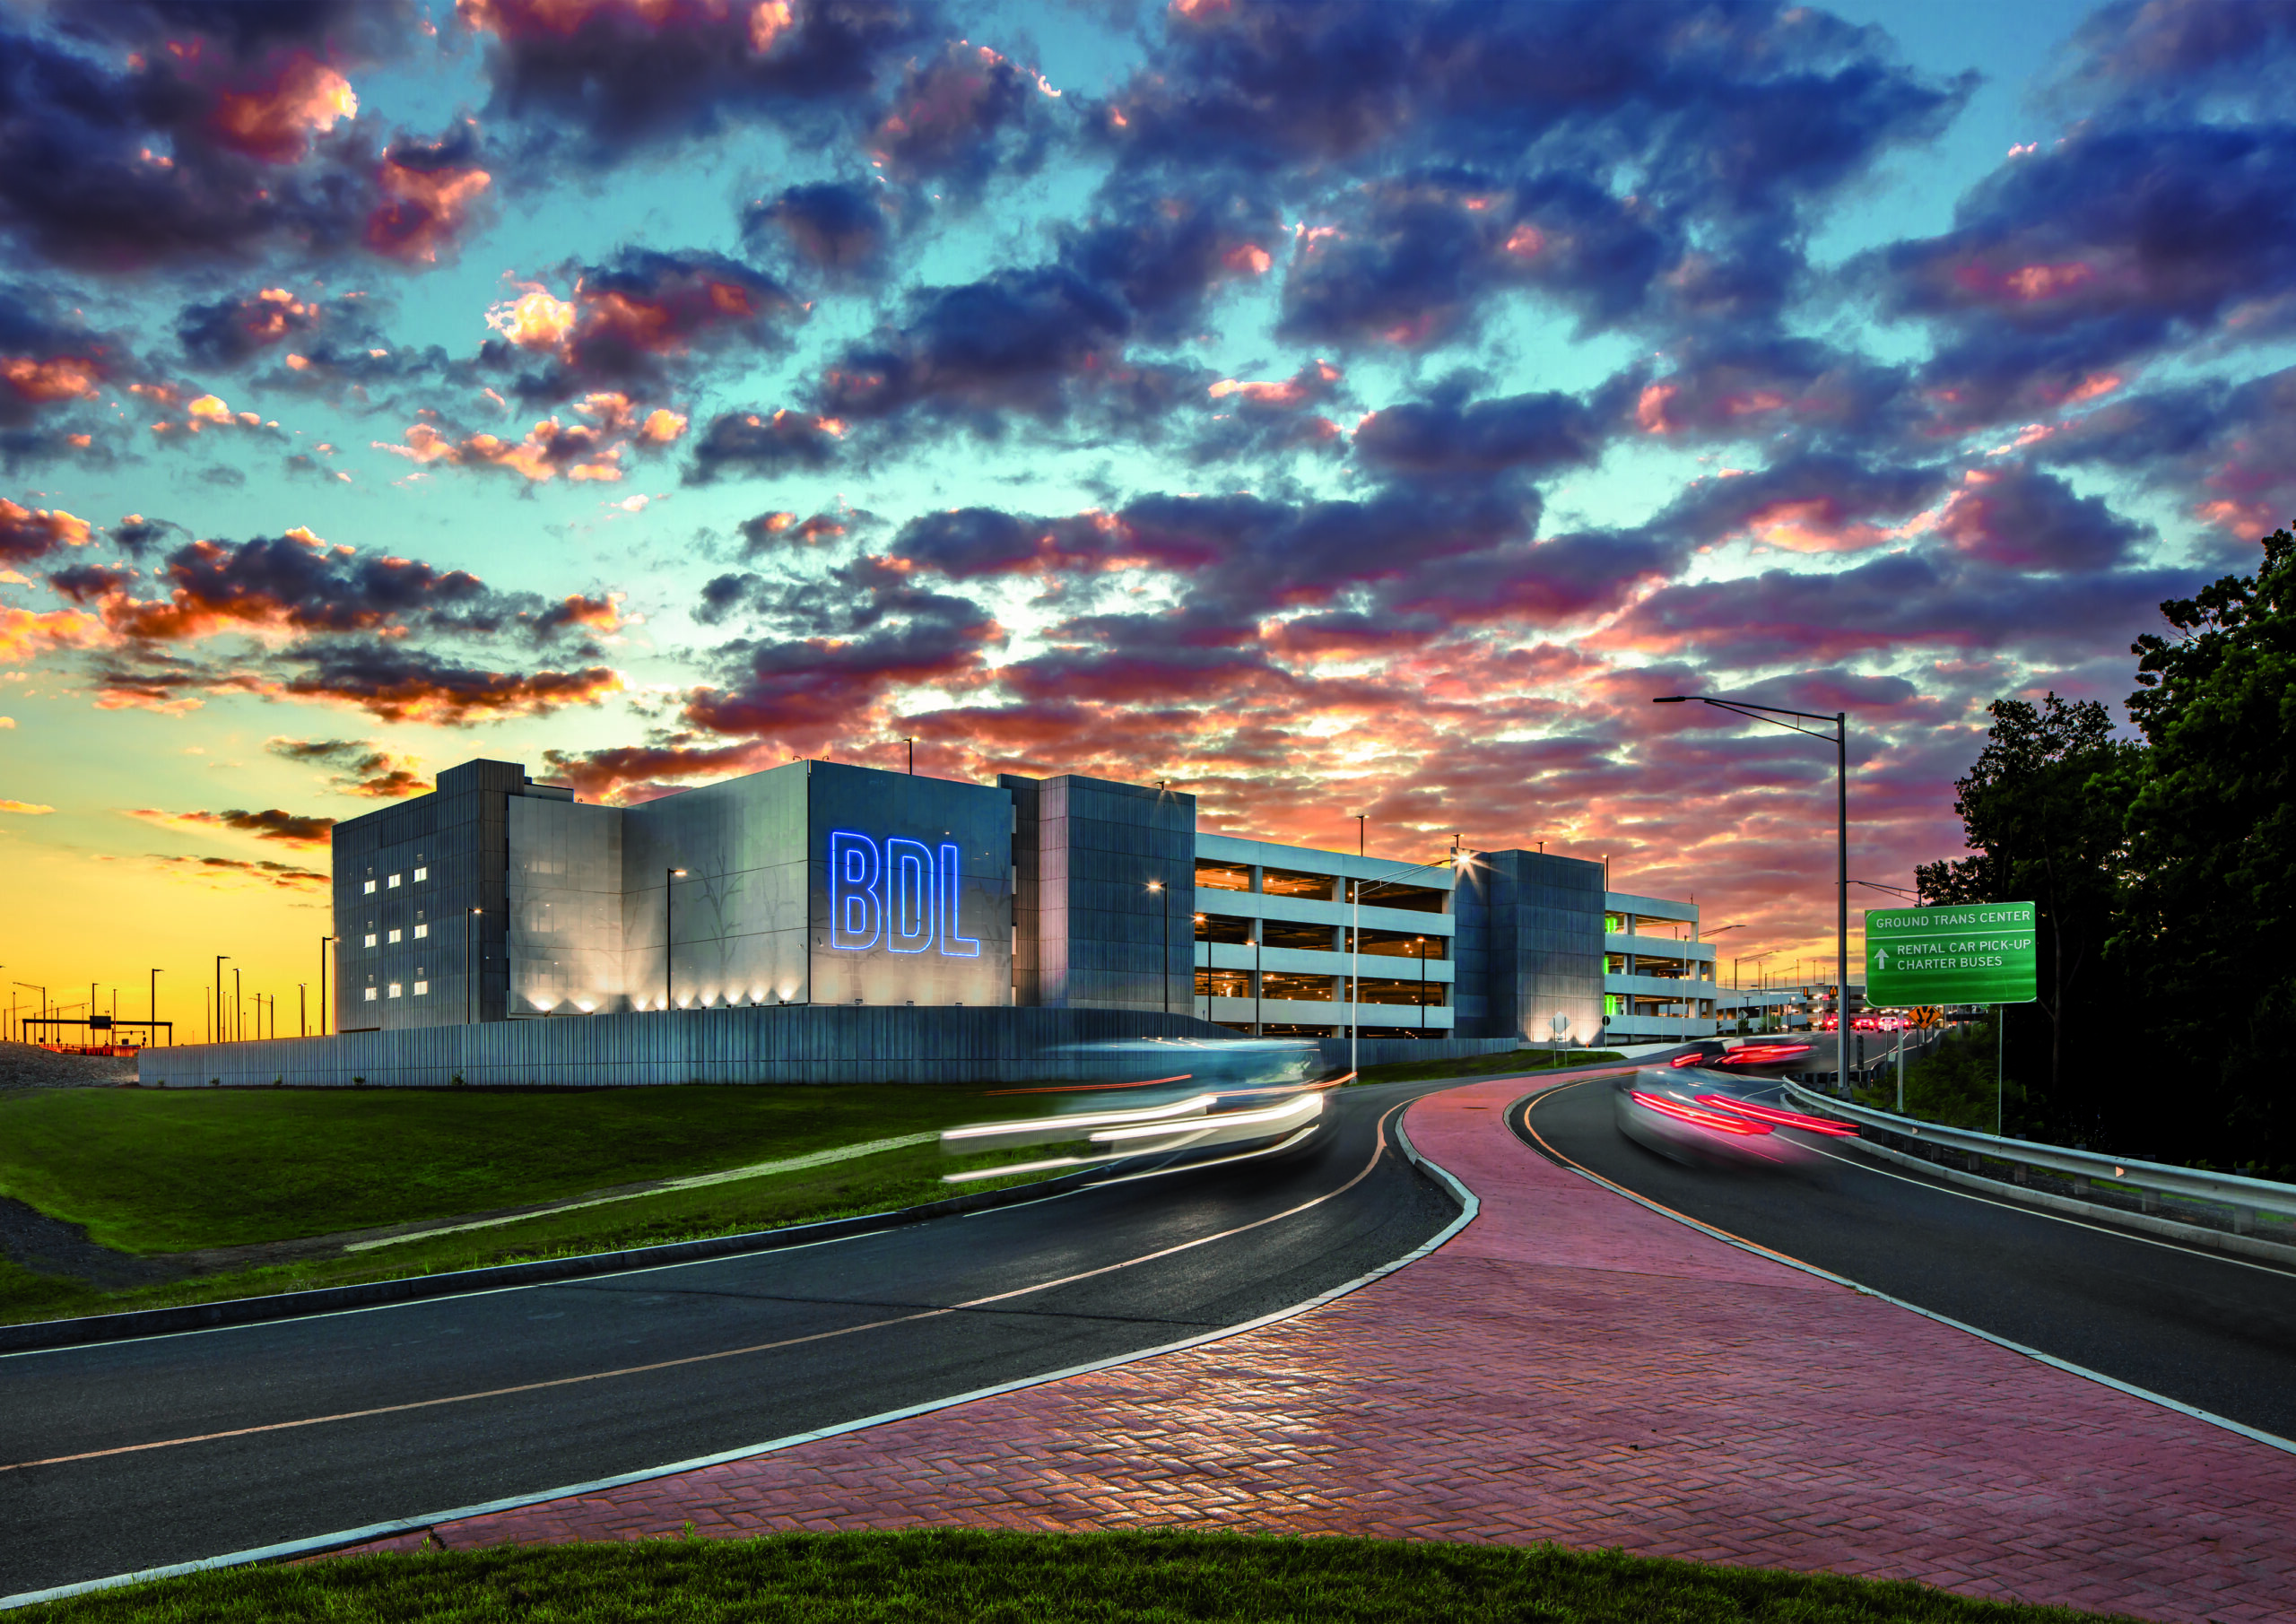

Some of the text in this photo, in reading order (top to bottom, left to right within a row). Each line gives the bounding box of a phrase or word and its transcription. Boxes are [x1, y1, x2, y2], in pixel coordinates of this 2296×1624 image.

[831, 830, 980, 958] BDL
[1875, 910, 2031, 929] GROUND TRANS CENTER
[1897, 939, 2031, 955] RENTAL CAR PICK-UP
[1897, 956, 2003, 970] CHARTER BUSES
